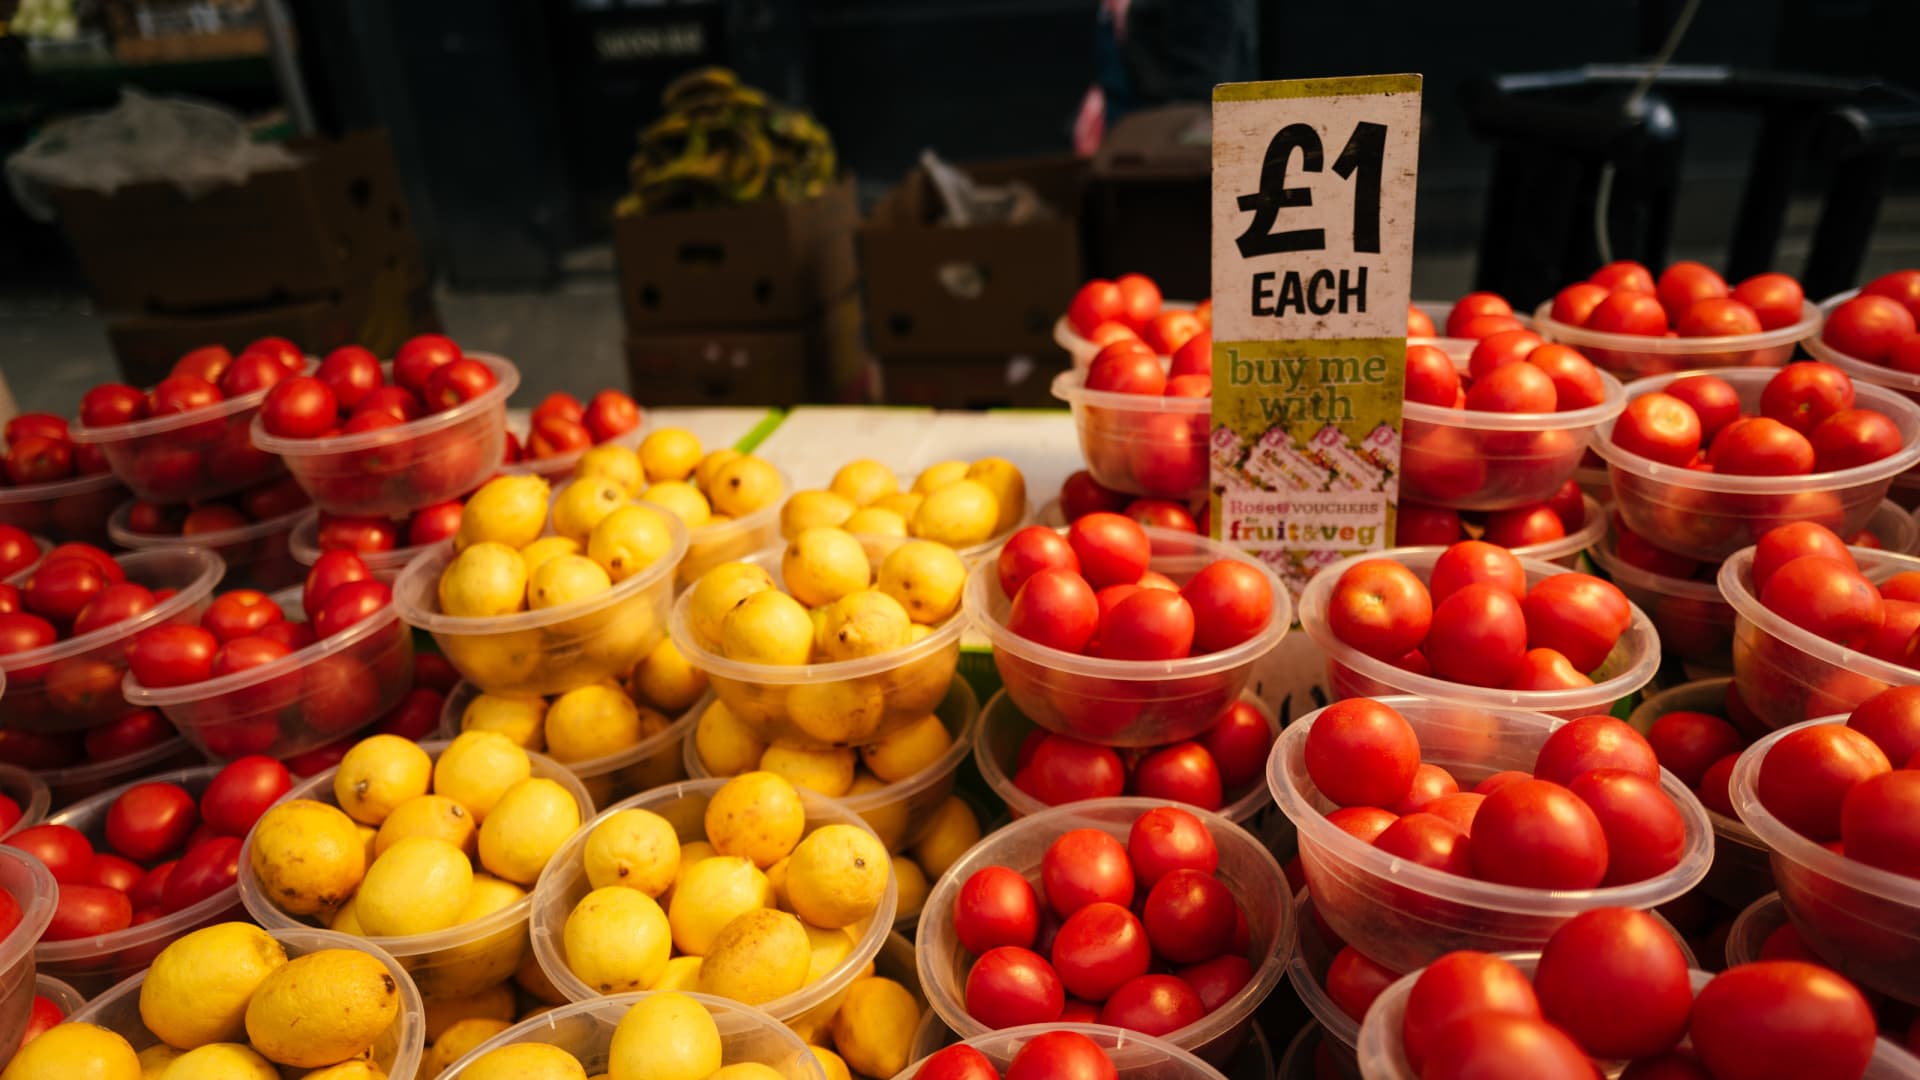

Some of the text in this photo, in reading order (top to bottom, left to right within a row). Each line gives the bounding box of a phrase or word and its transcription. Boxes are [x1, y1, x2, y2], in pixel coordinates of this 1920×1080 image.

[1235, 121, 1388, 258] £1
[1252, 266, 1368, 317] EACH
[1227, 349, 1387, 394] buy me
[1258, 385, 1354, 423] with
[1291, 503, 1379, 514] VOUCHERS
